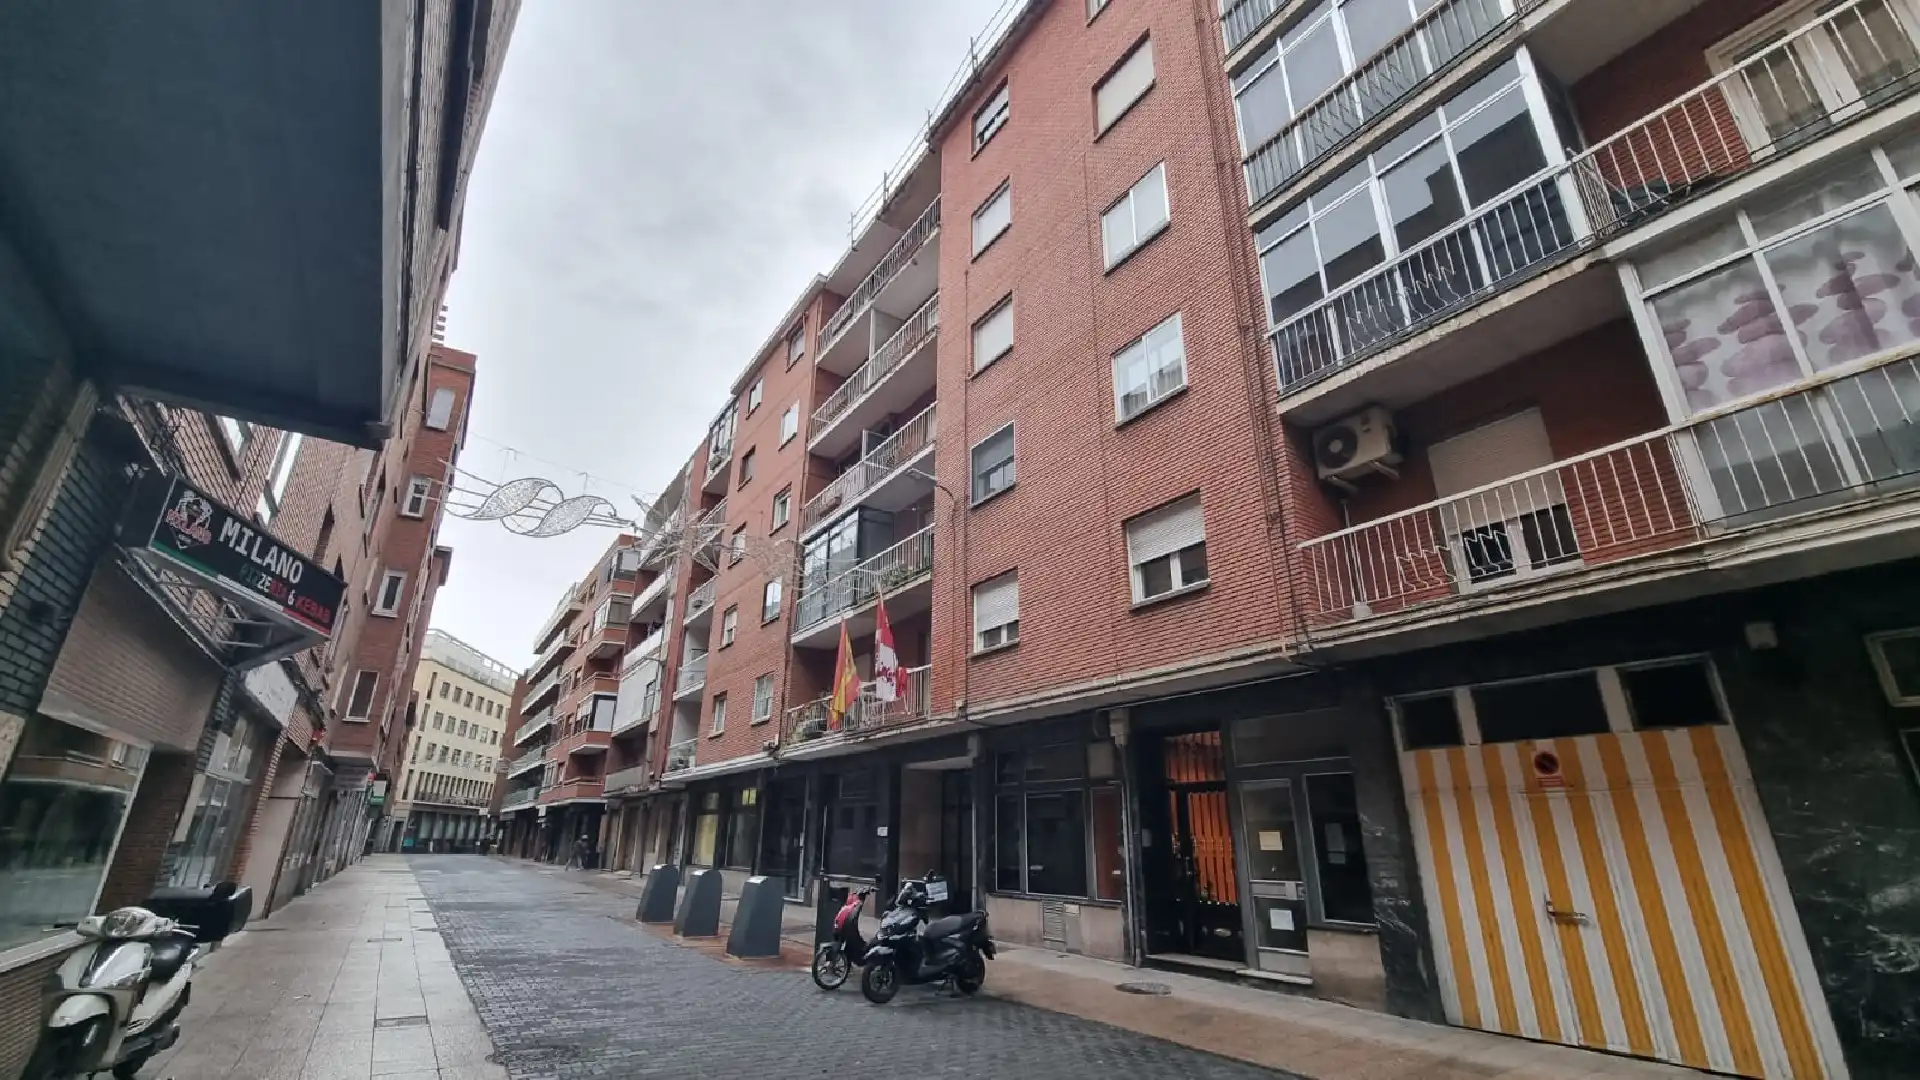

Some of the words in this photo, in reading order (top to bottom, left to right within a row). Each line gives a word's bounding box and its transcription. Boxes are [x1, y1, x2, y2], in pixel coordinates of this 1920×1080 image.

[219, 517, 303, 584] MILANO
[287, 589, 296, 606] &
[295, 595, 331, 623] KEBAB
